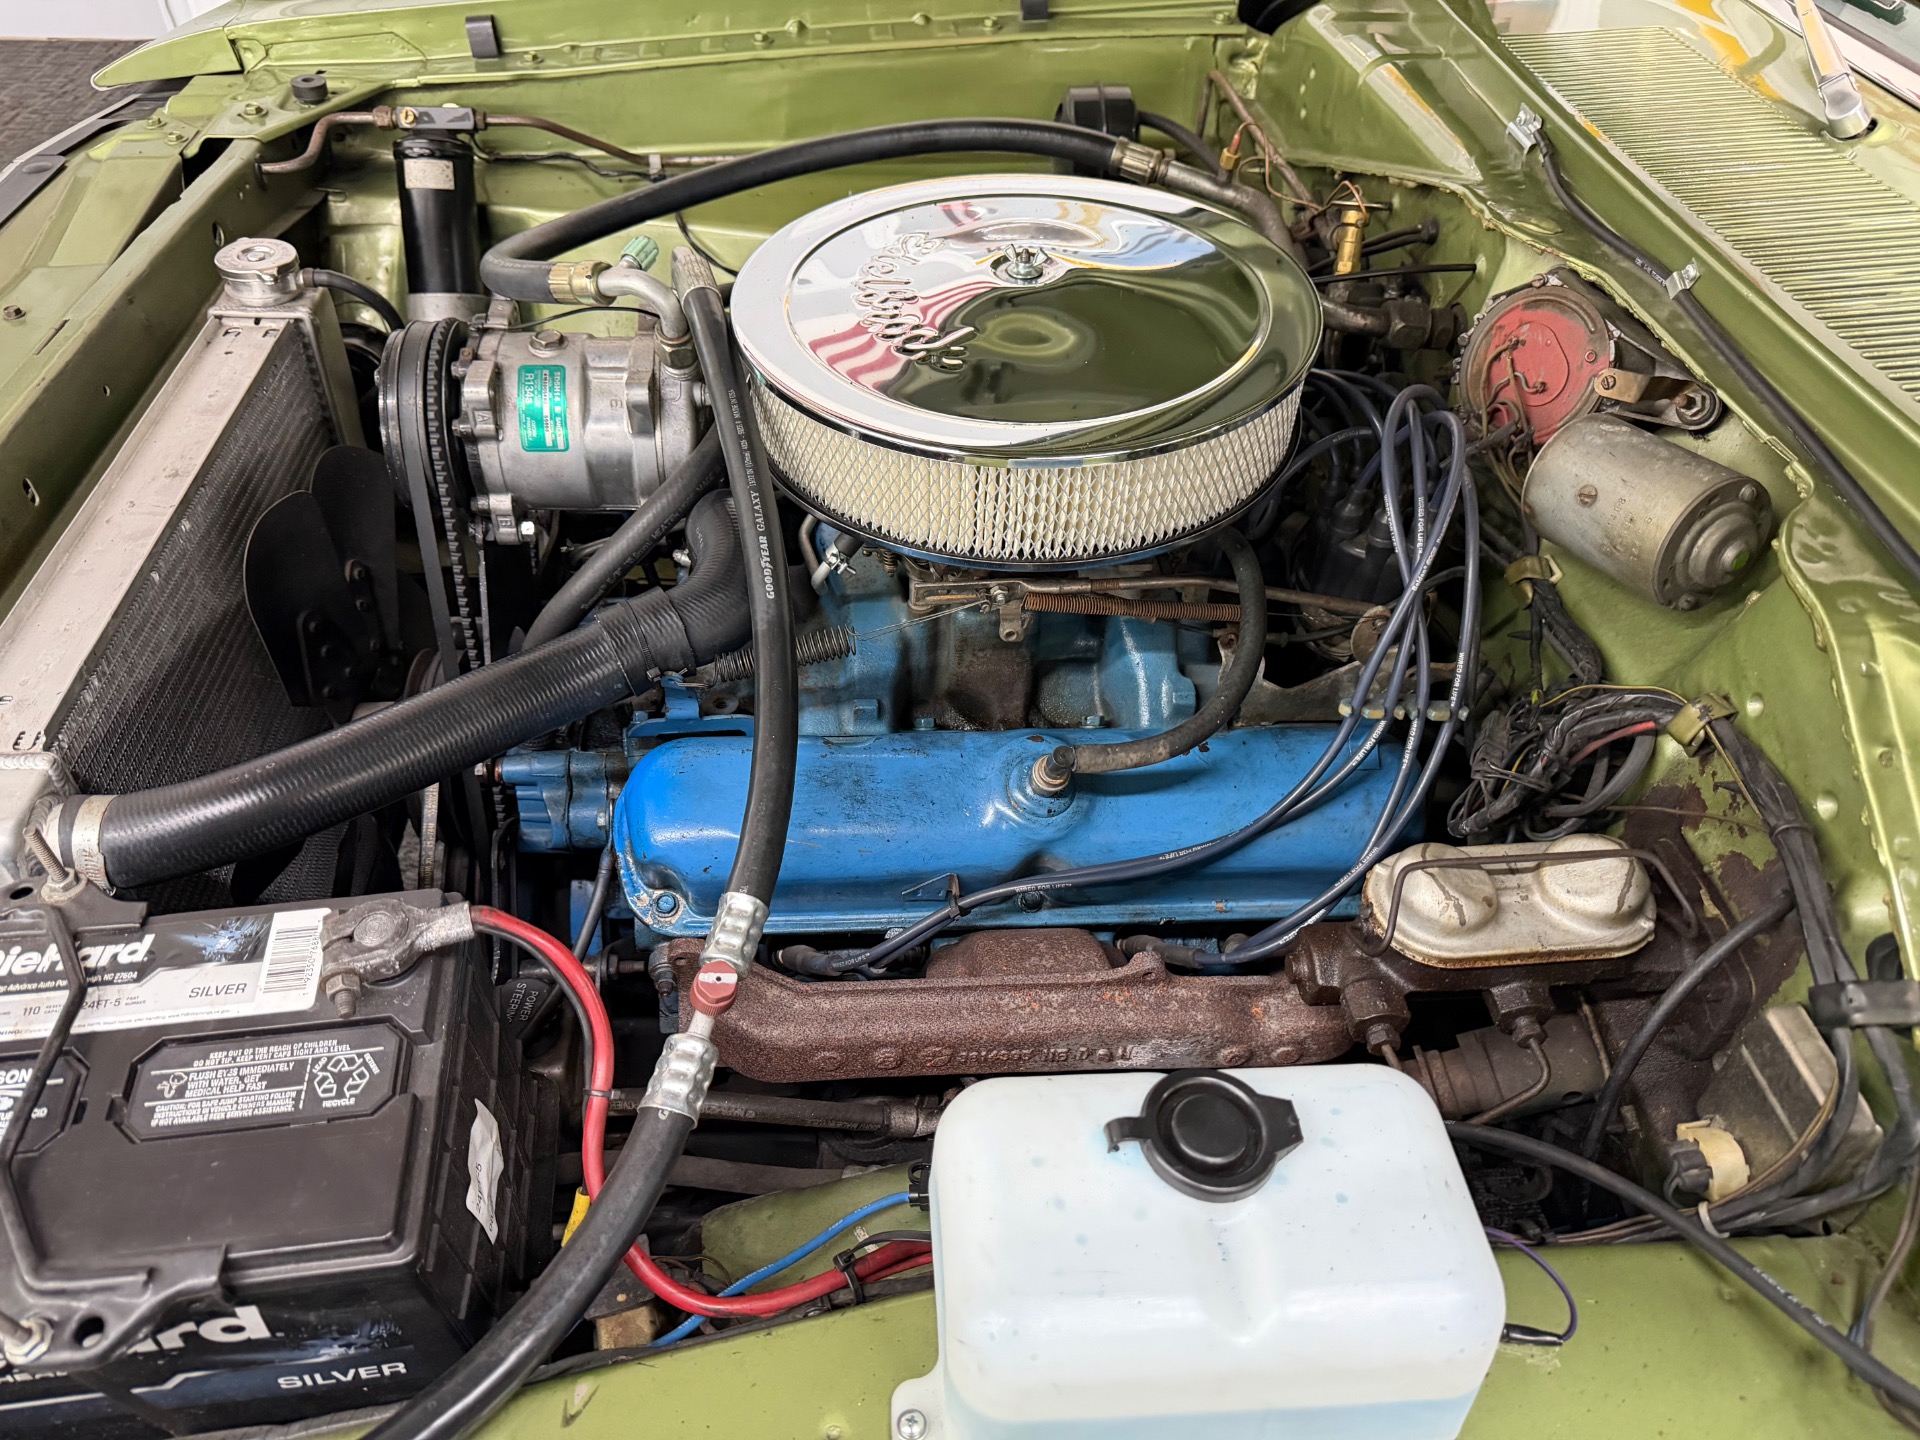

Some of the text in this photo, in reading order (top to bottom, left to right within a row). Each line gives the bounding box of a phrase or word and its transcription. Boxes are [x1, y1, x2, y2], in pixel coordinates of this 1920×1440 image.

[524, 373, 534, 404] R134a
[750, 490, 766, 532] GALAXY
[759, 535, 775, 599] GOODYEAR
[1457, 652, 1465, 673] WIRED
[1372, 720, 1388, 739] WIRED
[1015, 885, 1036, 893] WIRED
[114, 971, 138, 980] 27604
[8, 981, 38, 991] Advance
[38, 980, 55, 989] Auto
[188, 982, 248, 999] SILVER
[23, 1005, 41, 1016] 110
[519, 990, 539, 1021] POWER
[205, 1058, 220, 1066] NOT
[236, 1054, 254, 1062] KEEP
[255, 1052, 272, 1060] VENT
[274, 1050, 291, 1058] CAPS
[293, 1048, 313, 1056] TIGHT
[314, 1046, 328, 1054] AND
[330, 1044, 351, 1052] LEVEL
[210, 1051, 227, 1059] KEEP
[228, 1049, 242, 1057] OUT
[255, 1046, 268, 1054] THE
[269, 1044, 291, 1052] REACH
[293, 1042, 302, 1050] OF
[304, 1039, 338, 1049] CHILDREN
[189, 1062, 295, 1081] FLUSH EYES IMMEDIATELY
[312, 1057, 328, 1073] LEAD
[184, 1081, 267, 1098] MEDICAL HELP FAST
[187, 1080, 209, 1089] WITH
[244, 1074, 261, 1083] GET
[219, 1098, 237, 1106] JUMP
[238, 1094, 269, 1103] STARTING
[270, 1091, 297, 1100] FOLLOW
[322, 1097, 356, 1108] RECYCLE
[153, 1109, 201, 1119] INSTRUCTIONS
[211, 1104, 237, 1113] VEHICLE
[159, 1118, 173, 1126] NOT
[173, 1114, 209, 1125] AVAILABLE
[209, 1112, 225, 1121] SEEK
[226, 1109, 253, 1119] SERVICE
[277, 1360, 408, 1390] SILVER
